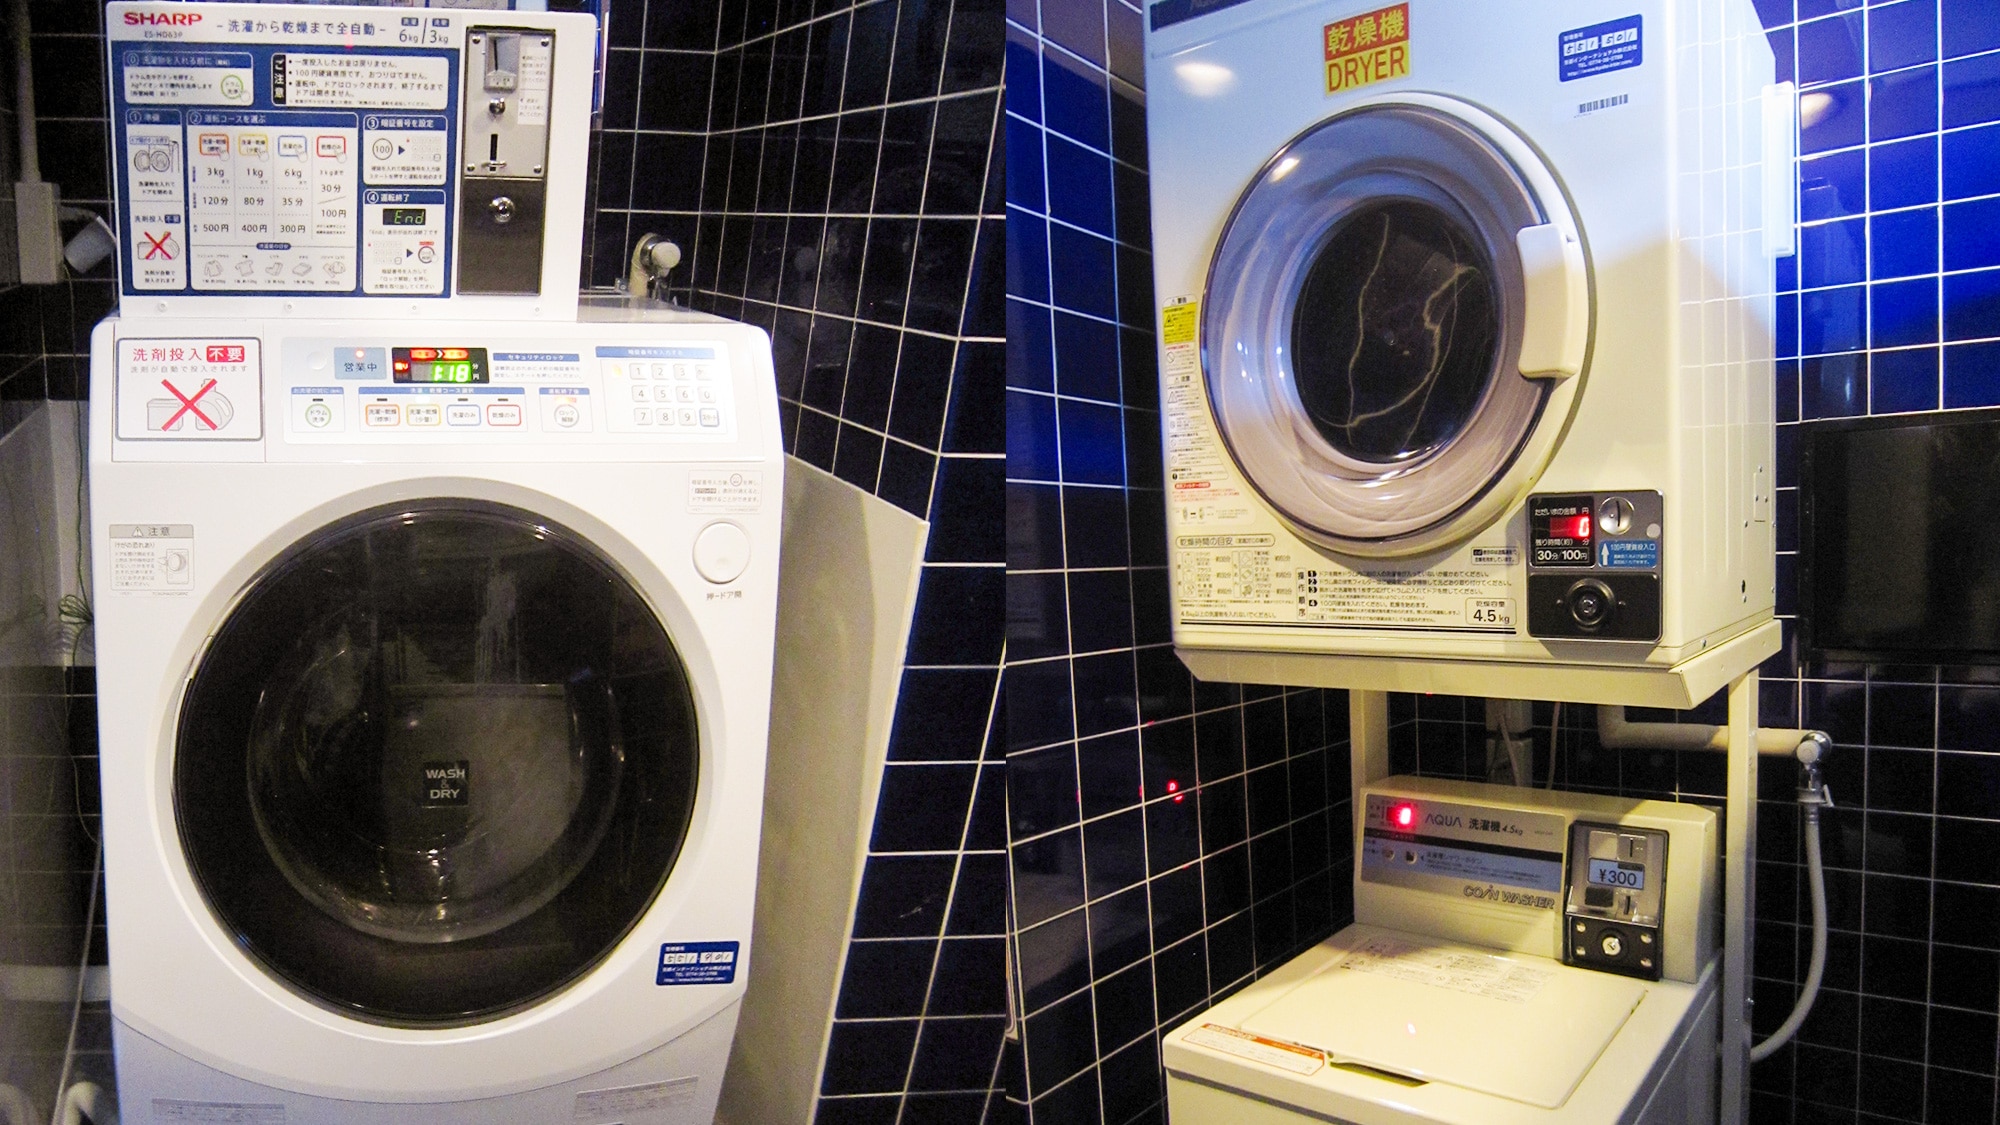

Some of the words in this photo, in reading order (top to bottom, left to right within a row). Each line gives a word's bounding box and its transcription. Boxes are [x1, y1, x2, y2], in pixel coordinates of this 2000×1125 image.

[124, 12, 203, 26] SHARP
[1327, 9, 1404, 55] 乾燥機
[1328, 45, 1405, 92] DRYER
[380, 194, 410, 203] 運転終了
[394, 210, 425, 225] End
[133, 348, 202, 361] 洗剤投入
[209, 347, 243, 361] 不要
[130, 365, 248, 373] 洗剤が自動で投入されます
[344, 362, 378, 373] 営業中
[636, 367, 641, 375] 1
[658, 367, 664, 376] 2
[680, 367, 686, 376] 3
[638, 389, 645, 398] 4
[660, 389, 666, 398] 5
[682, 390, 688, 398] 6
[640, 412, 646, 420] 7
[662, 412, 669, 421] 8
[684, 413, 691, 421] 9
[1535, 508, 1577, 516] ただいまの金額
[148, 526, 170, 536] 注意
[425, 769, 465, 779] WASH
[440, 779, 450, 788] &
[430, 789, 460, 799] DRY
[1425, 814, 1463, 828] AQUA
[1469, 817, 1501, 832] 洗濯機
[1599, 868, 1637, 886] ¥300
[1501, 891, 1555, 909] WASHER
